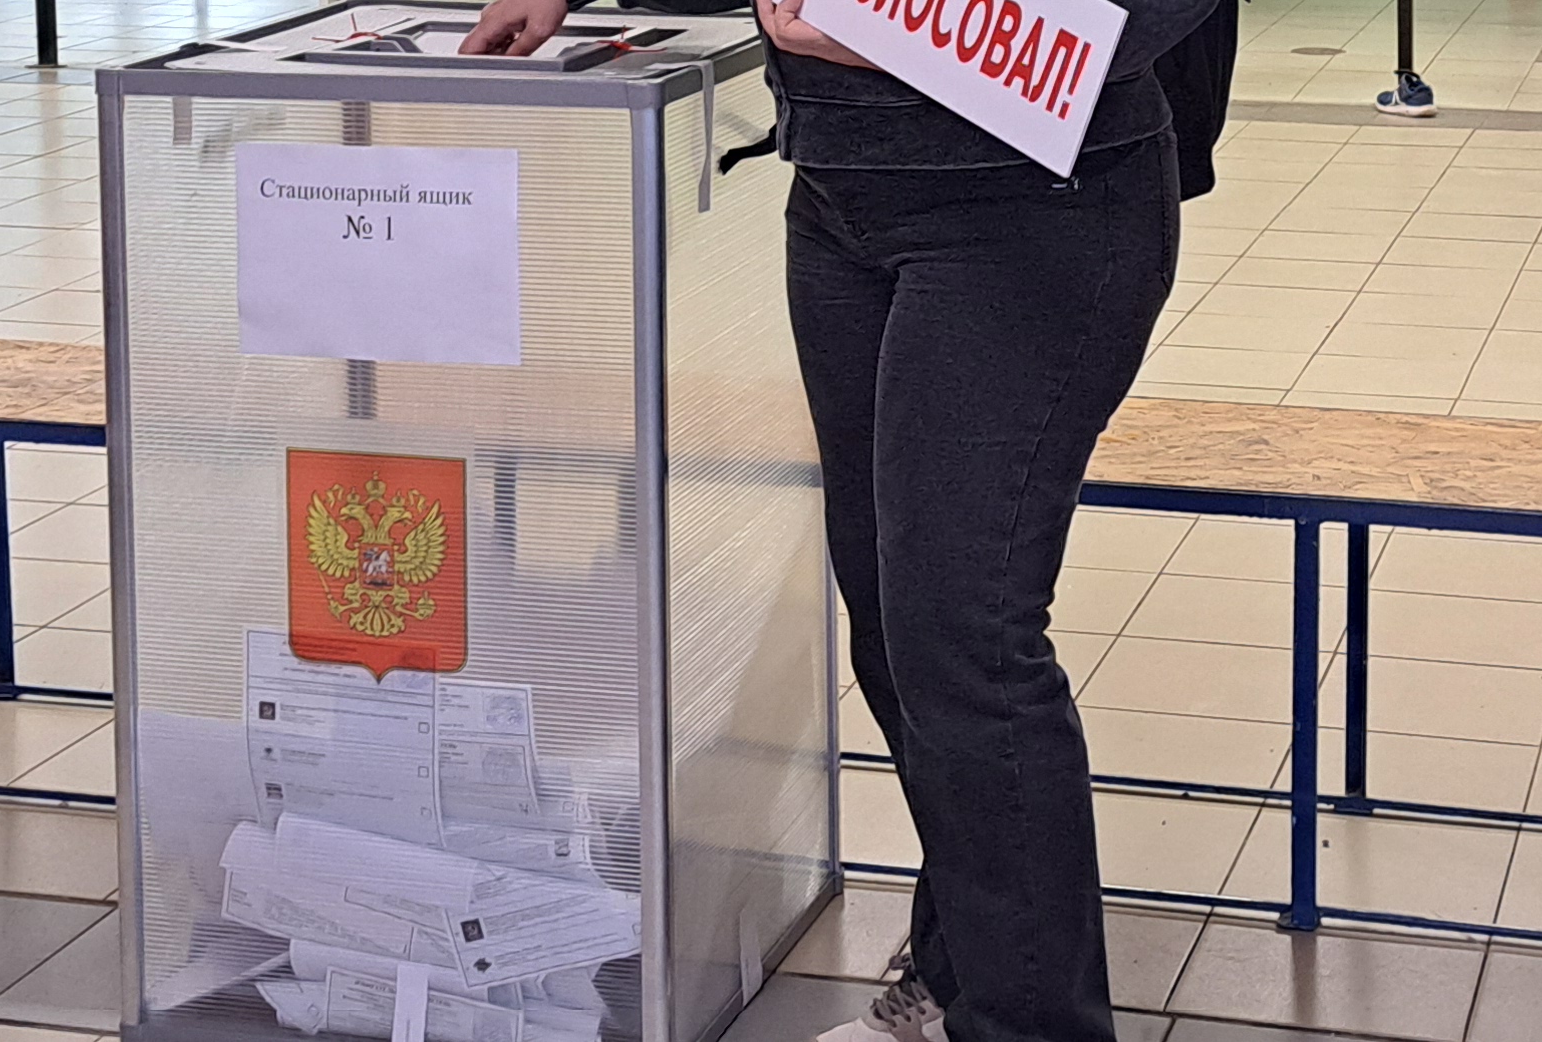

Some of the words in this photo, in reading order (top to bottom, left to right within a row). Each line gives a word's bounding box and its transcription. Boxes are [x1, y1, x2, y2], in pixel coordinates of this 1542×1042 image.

[260, 177, 410, 207] Стационарный
[417, 189, 474, 207] ящик
[342, 214, 373, 240] №
[385, 216, 395, 241] 1
